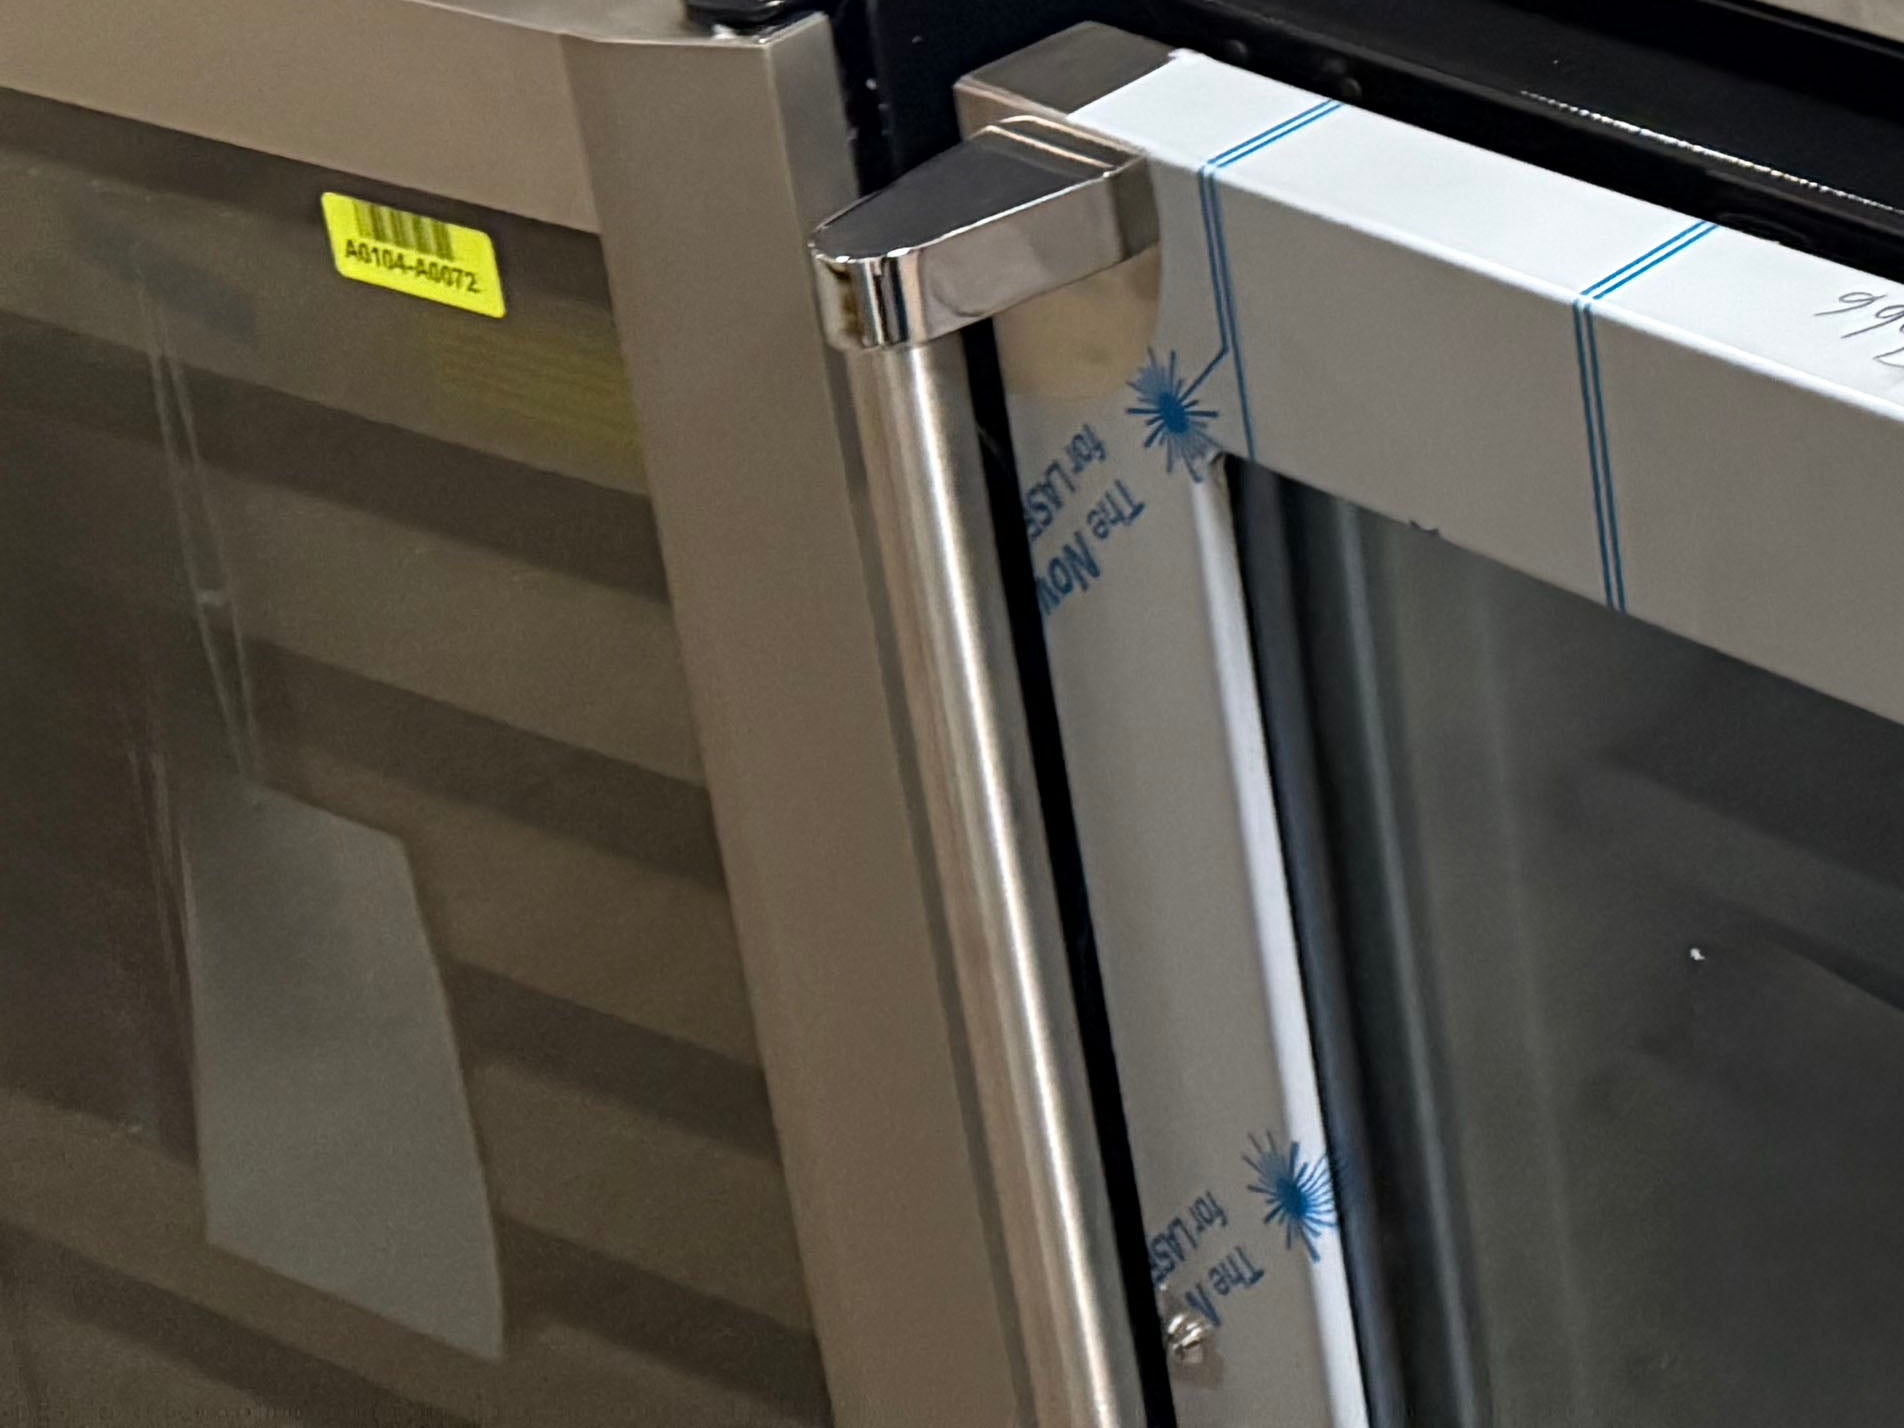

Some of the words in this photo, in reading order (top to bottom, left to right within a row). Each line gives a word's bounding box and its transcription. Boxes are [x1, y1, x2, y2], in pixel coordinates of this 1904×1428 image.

[344, 238, 481, 294] A0104-A0072
[1064, 423, 1107, 475] for
[1086, 479, 1146, 540] The
[1189, 1190, 1228, 1234] for
[1207, 1246, 1265, 1296] The
